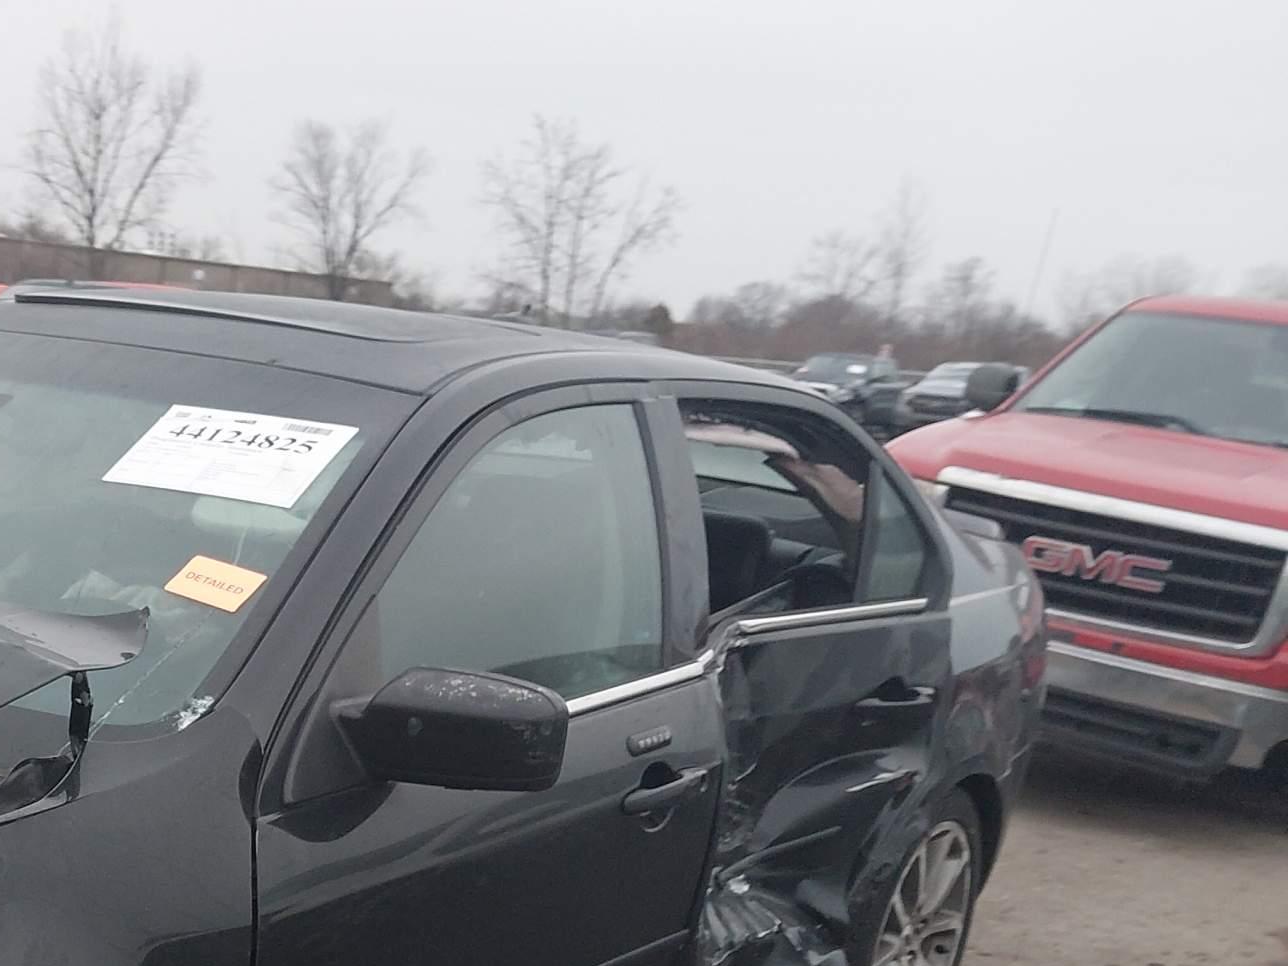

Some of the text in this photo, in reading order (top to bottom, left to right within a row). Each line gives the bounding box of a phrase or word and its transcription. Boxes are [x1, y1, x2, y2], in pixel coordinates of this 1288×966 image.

[169, 424, 318, 454] 44124825
[1024, 536, 1172, 593] GMC
[185, 570, 244, 595] DETAILED
